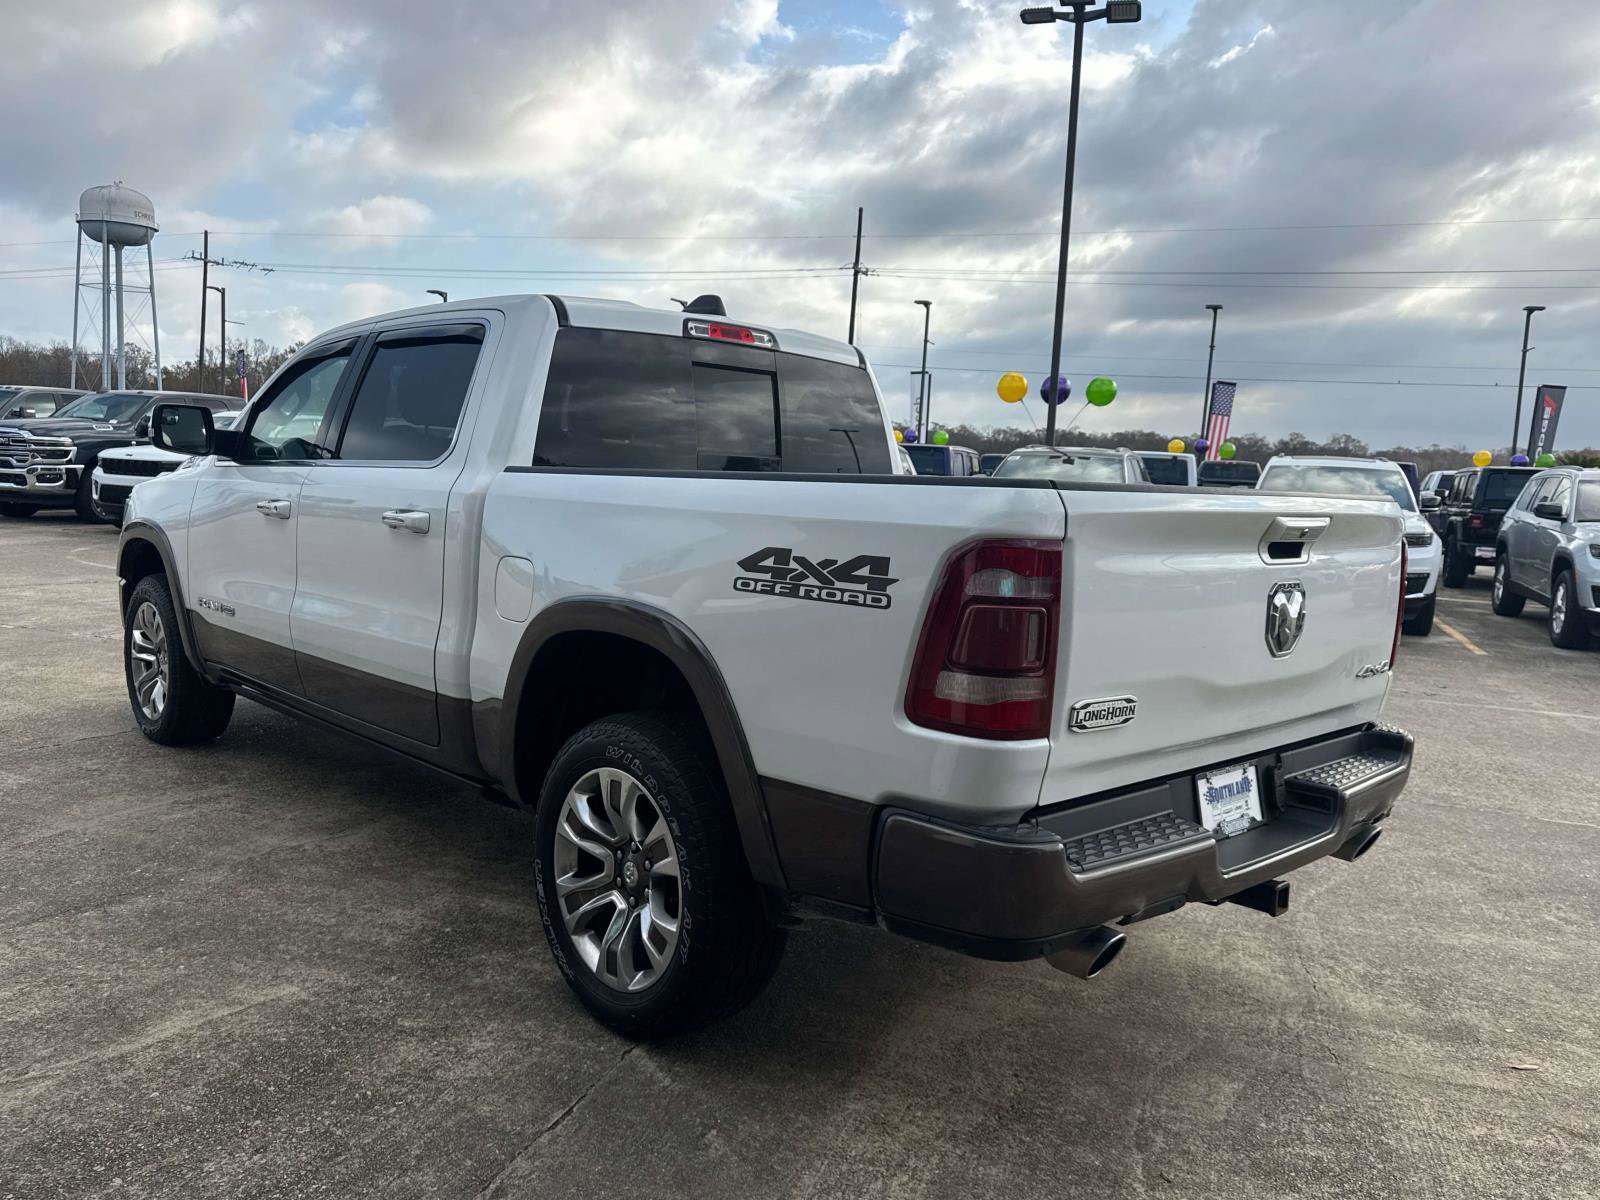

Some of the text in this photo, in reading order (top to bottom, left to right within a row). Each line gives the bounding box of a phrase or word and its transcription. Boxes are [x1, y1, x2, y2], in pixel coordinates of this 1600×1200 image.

[1533, 406, 1552, 467] ODGE
[736, 579, 888, 607] OFF ROAD
[1074, 704, 1137, 725] LONGHORN
